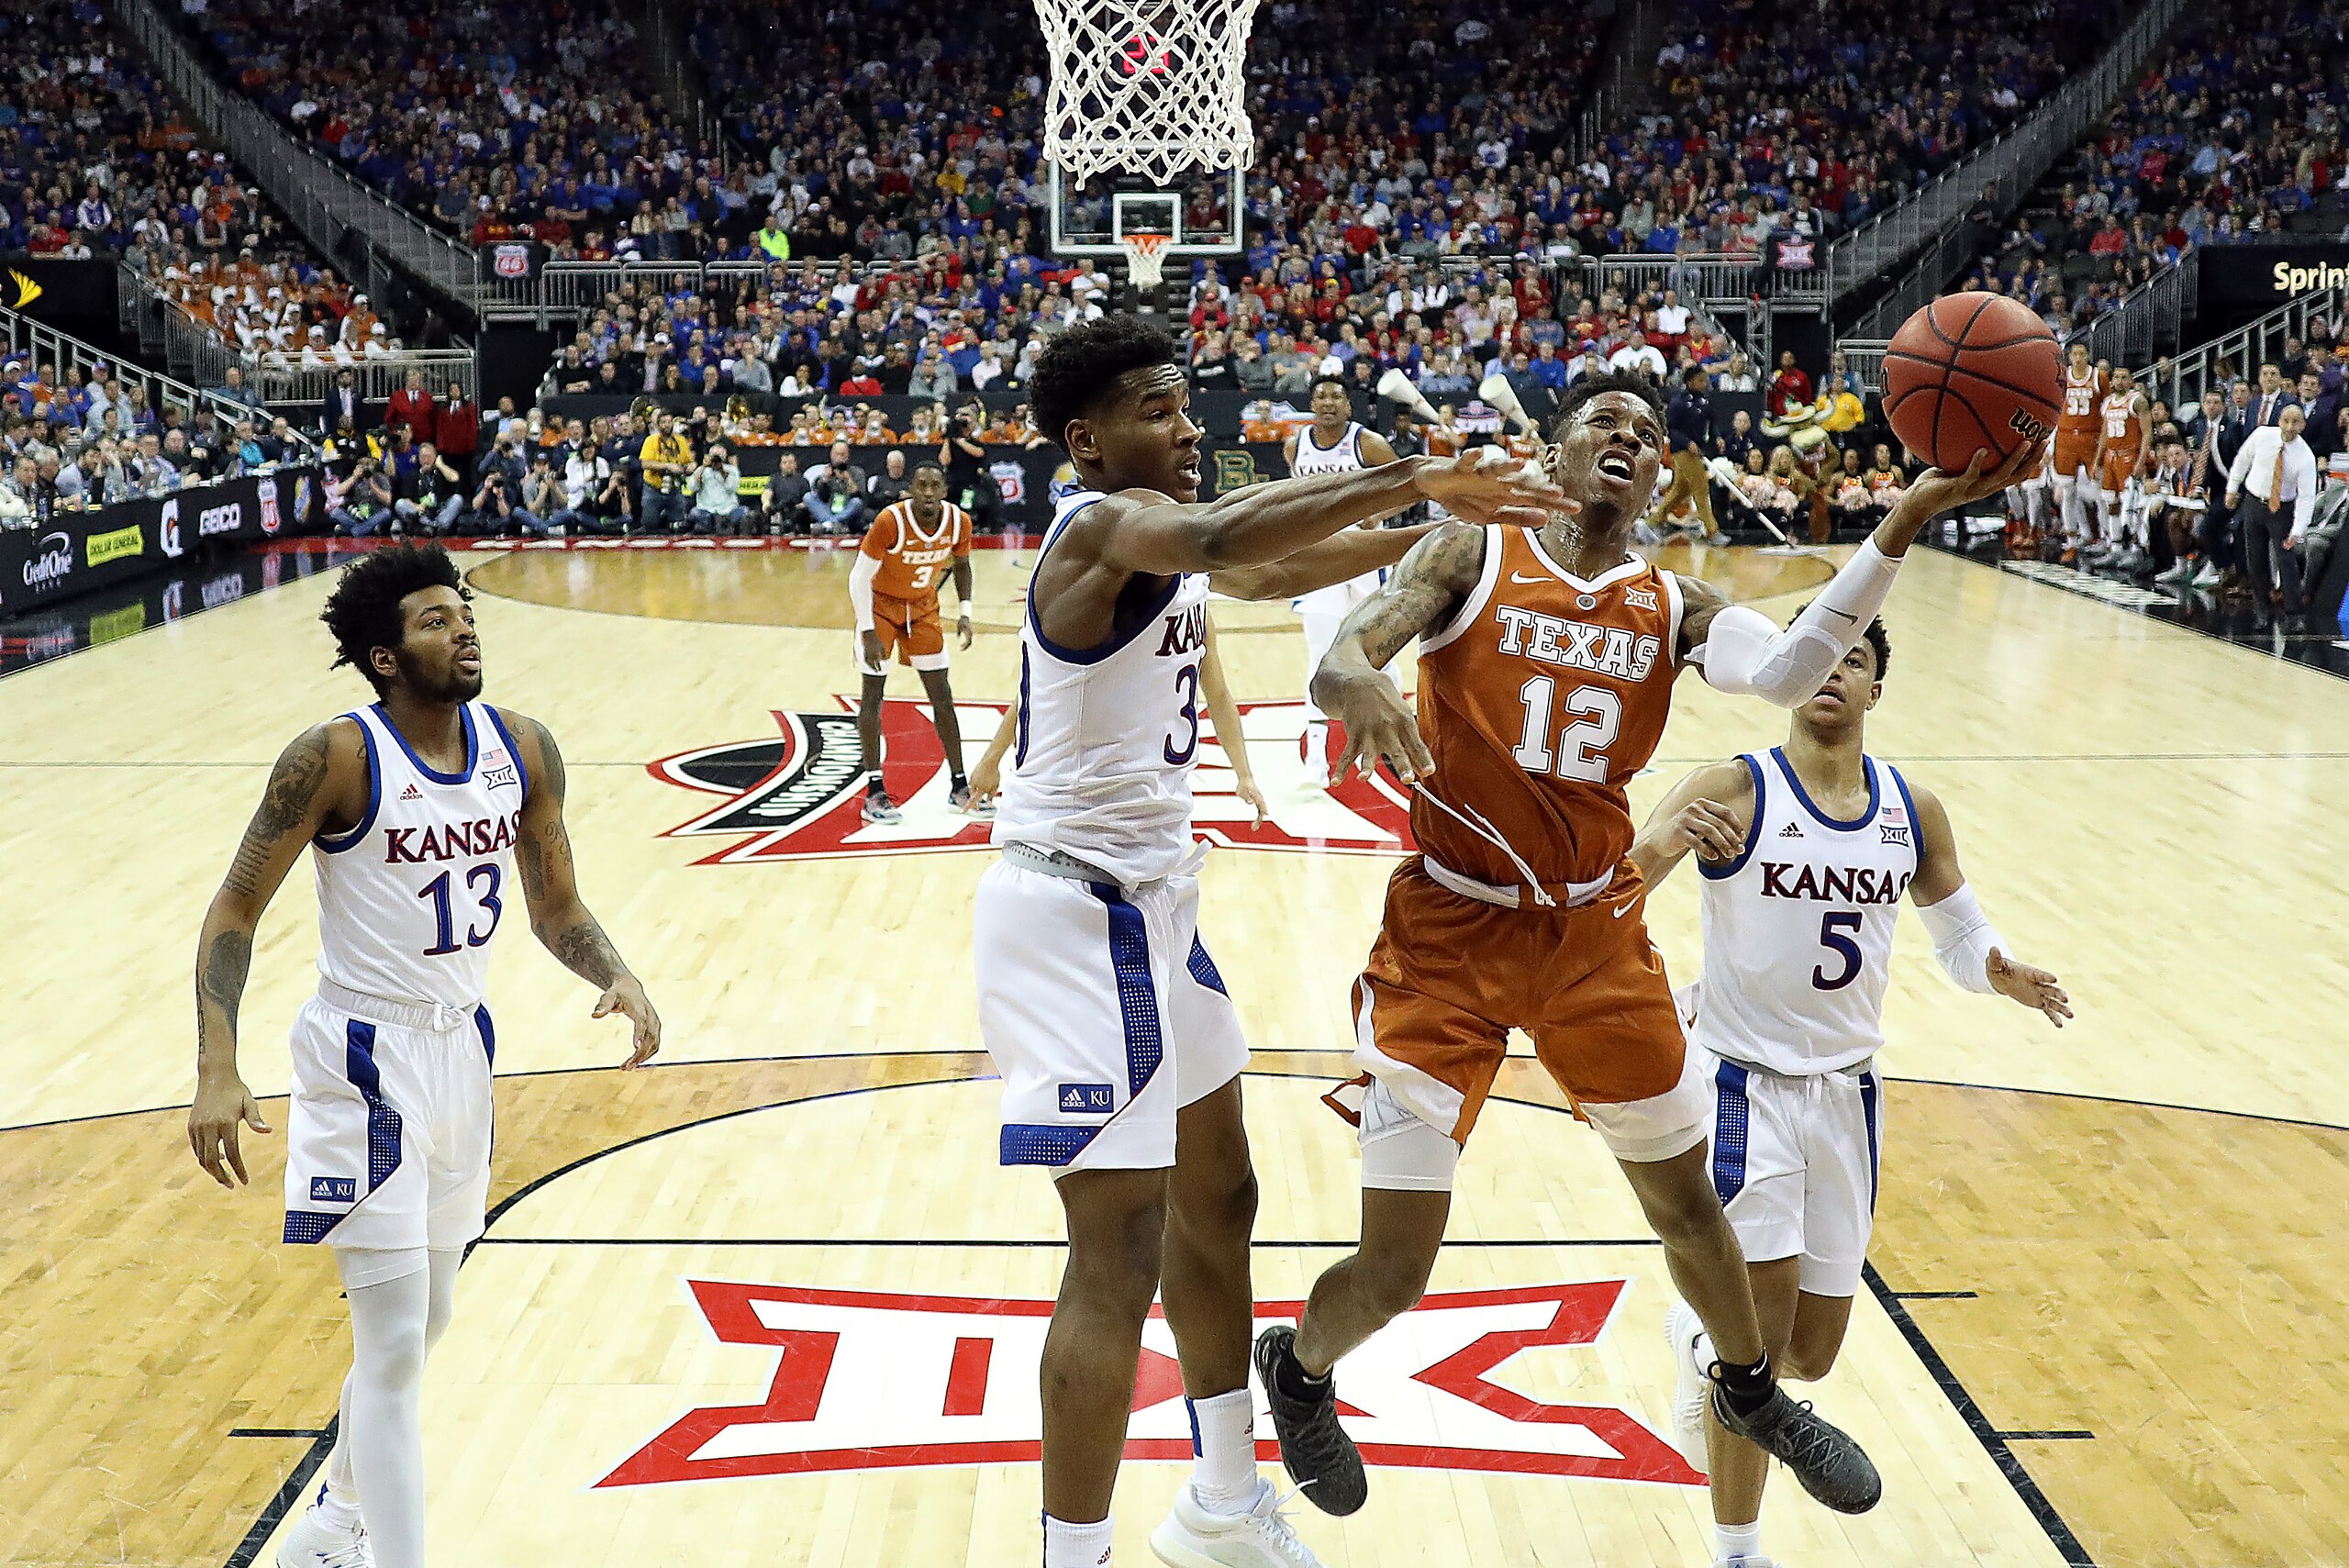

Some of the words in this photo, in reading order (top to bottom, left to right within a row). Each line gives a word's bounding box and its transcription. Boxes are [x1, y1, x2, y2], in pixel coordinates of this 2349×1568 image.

[911, 565, 934, 588] 3
[1496, 604, 1661, 683] TEXAS
[1512, 675, 1623, 785] 12
[384, 810, 522, 864] KANSAS
[417, 862, 503, 956] 13
[1811, 911, 1864, 992] 5
[1090, 1090, 1110, 1106] KU
[336, 1183, 353, 1196] KU
